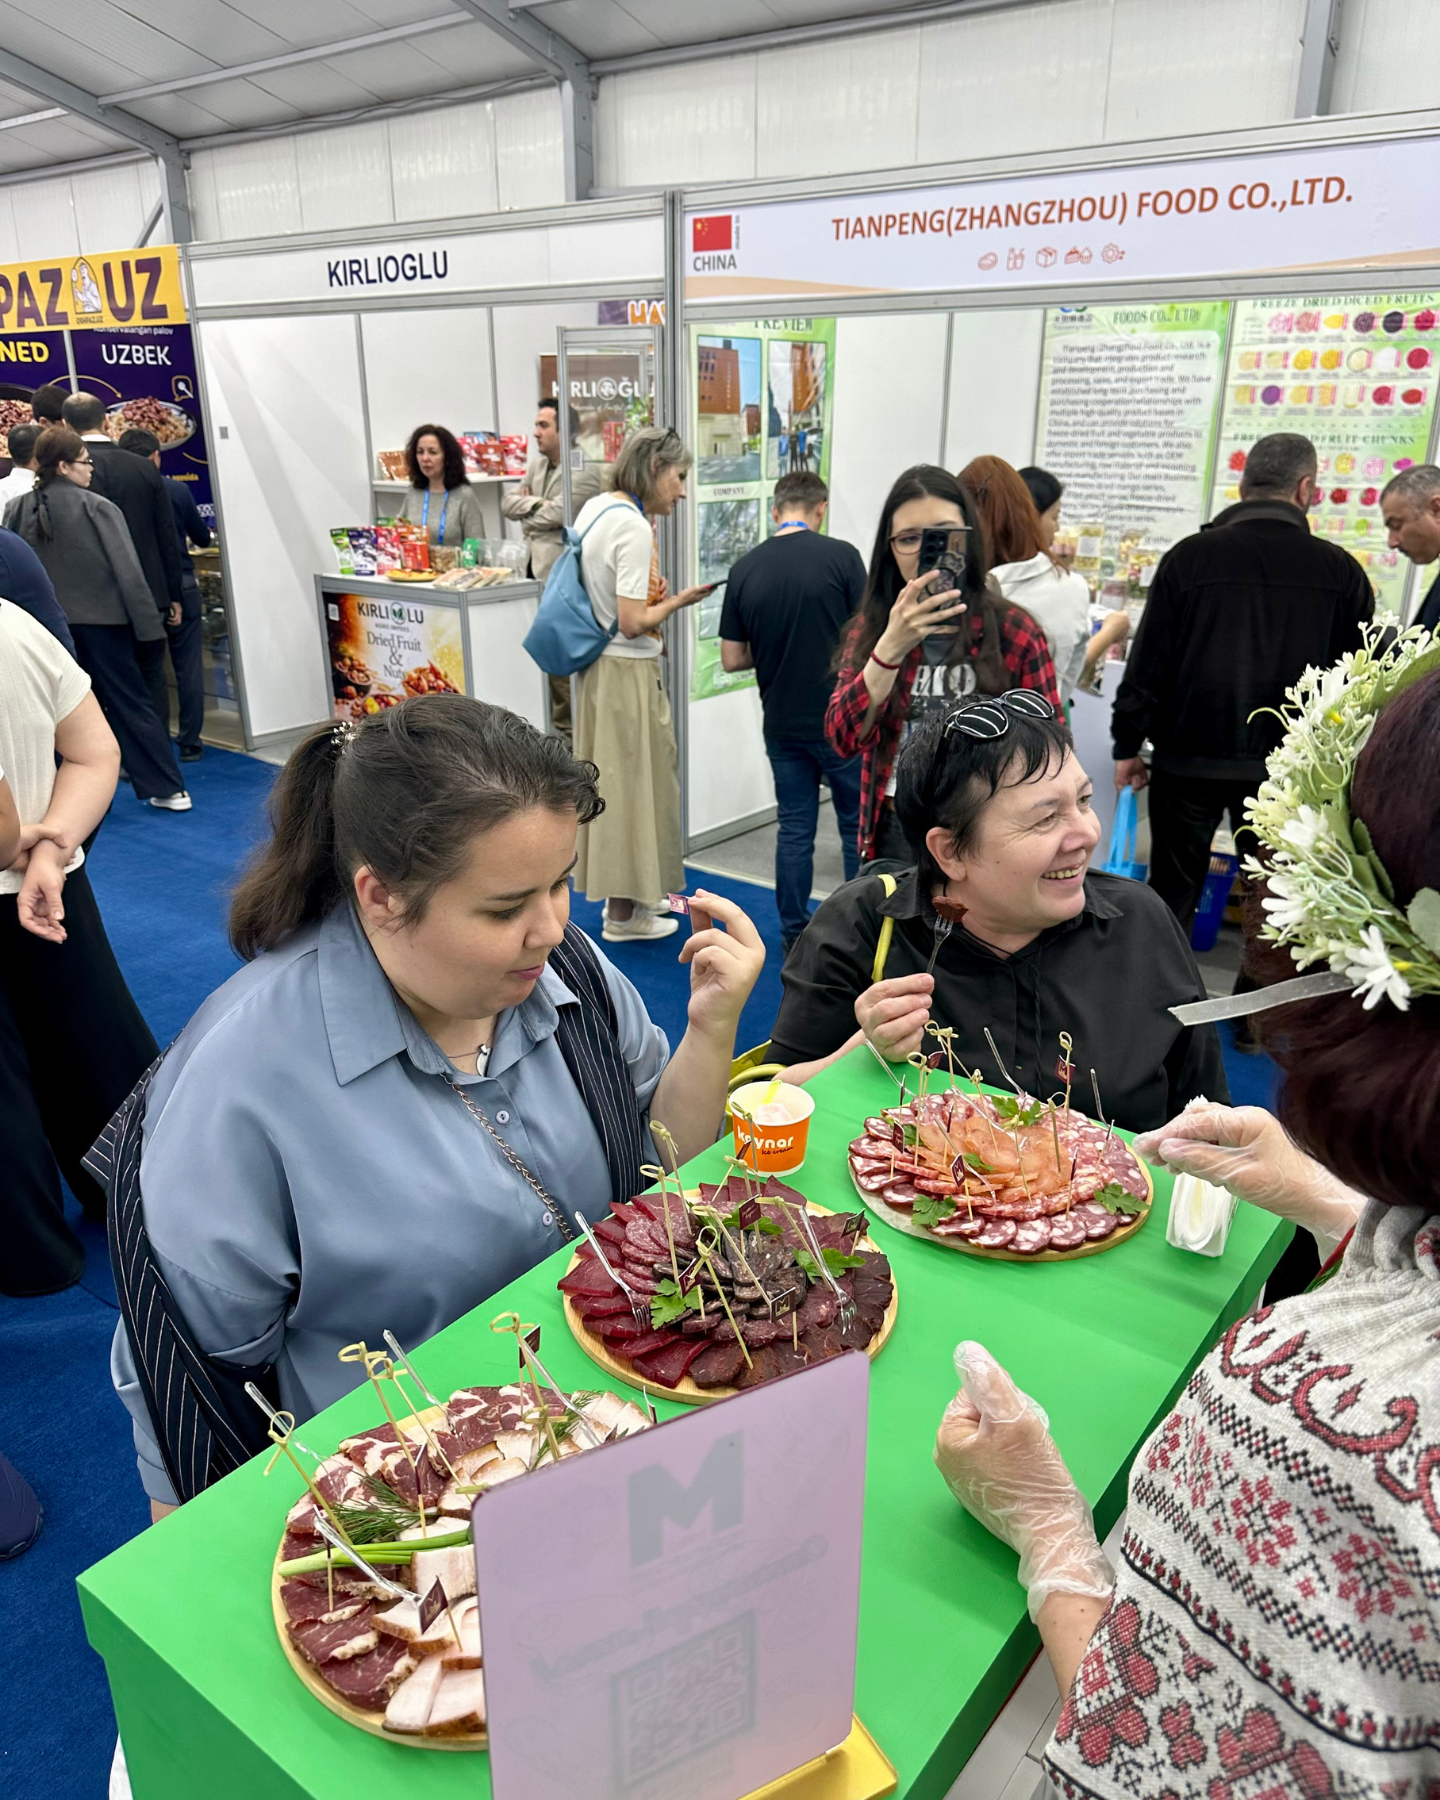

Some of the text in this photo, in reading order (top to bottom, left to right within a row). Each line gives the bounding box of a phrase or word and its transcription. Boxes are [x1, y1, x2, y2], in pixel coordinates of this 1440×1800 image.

[832, 176, 1353, 241] TIANPENG(ZHANGZHOU) FOOD CO.,LTD.
[327, 250, 448, 287] KIRLIOGLU
[693, 254, 737, 271] CHINA
[103, 256, 169, 322] UZ
[101, 343, 172, 366] UZBEK
[367, 631, 422, 652] Dried Fruit
[389, 649, 404, 666] &
[383, 665, 406, 680] Nuts
